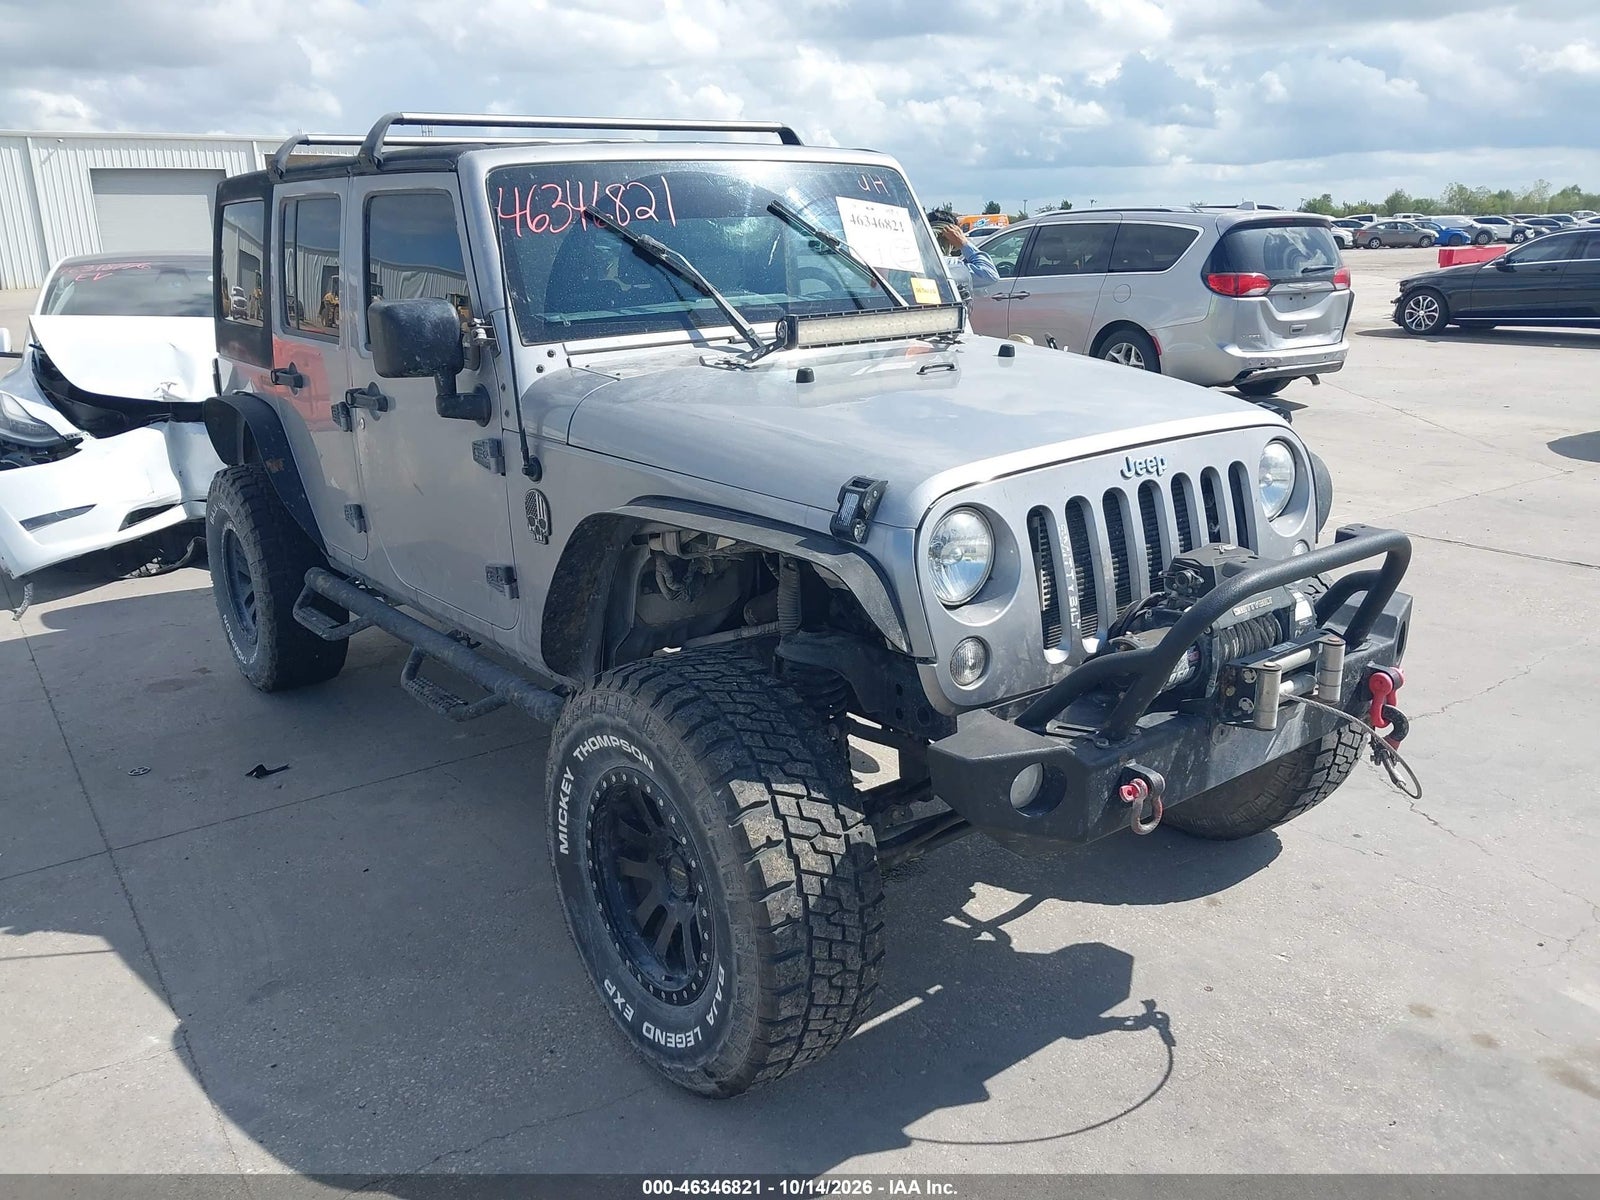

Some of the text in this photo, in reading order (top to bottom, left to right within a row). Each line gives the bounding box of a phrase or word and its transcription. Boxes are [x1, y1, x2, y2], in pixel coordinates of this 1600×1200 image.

[497, 175, 676, 237] 46346821
[849, 213, 905, 233] 46346821
[1120, 455, 1168, 480] Jeep
[559, 735, 655, 855] MICKEY THOMPSON
[604, 963, 725, 1048] BAJA LEGEND EXP
